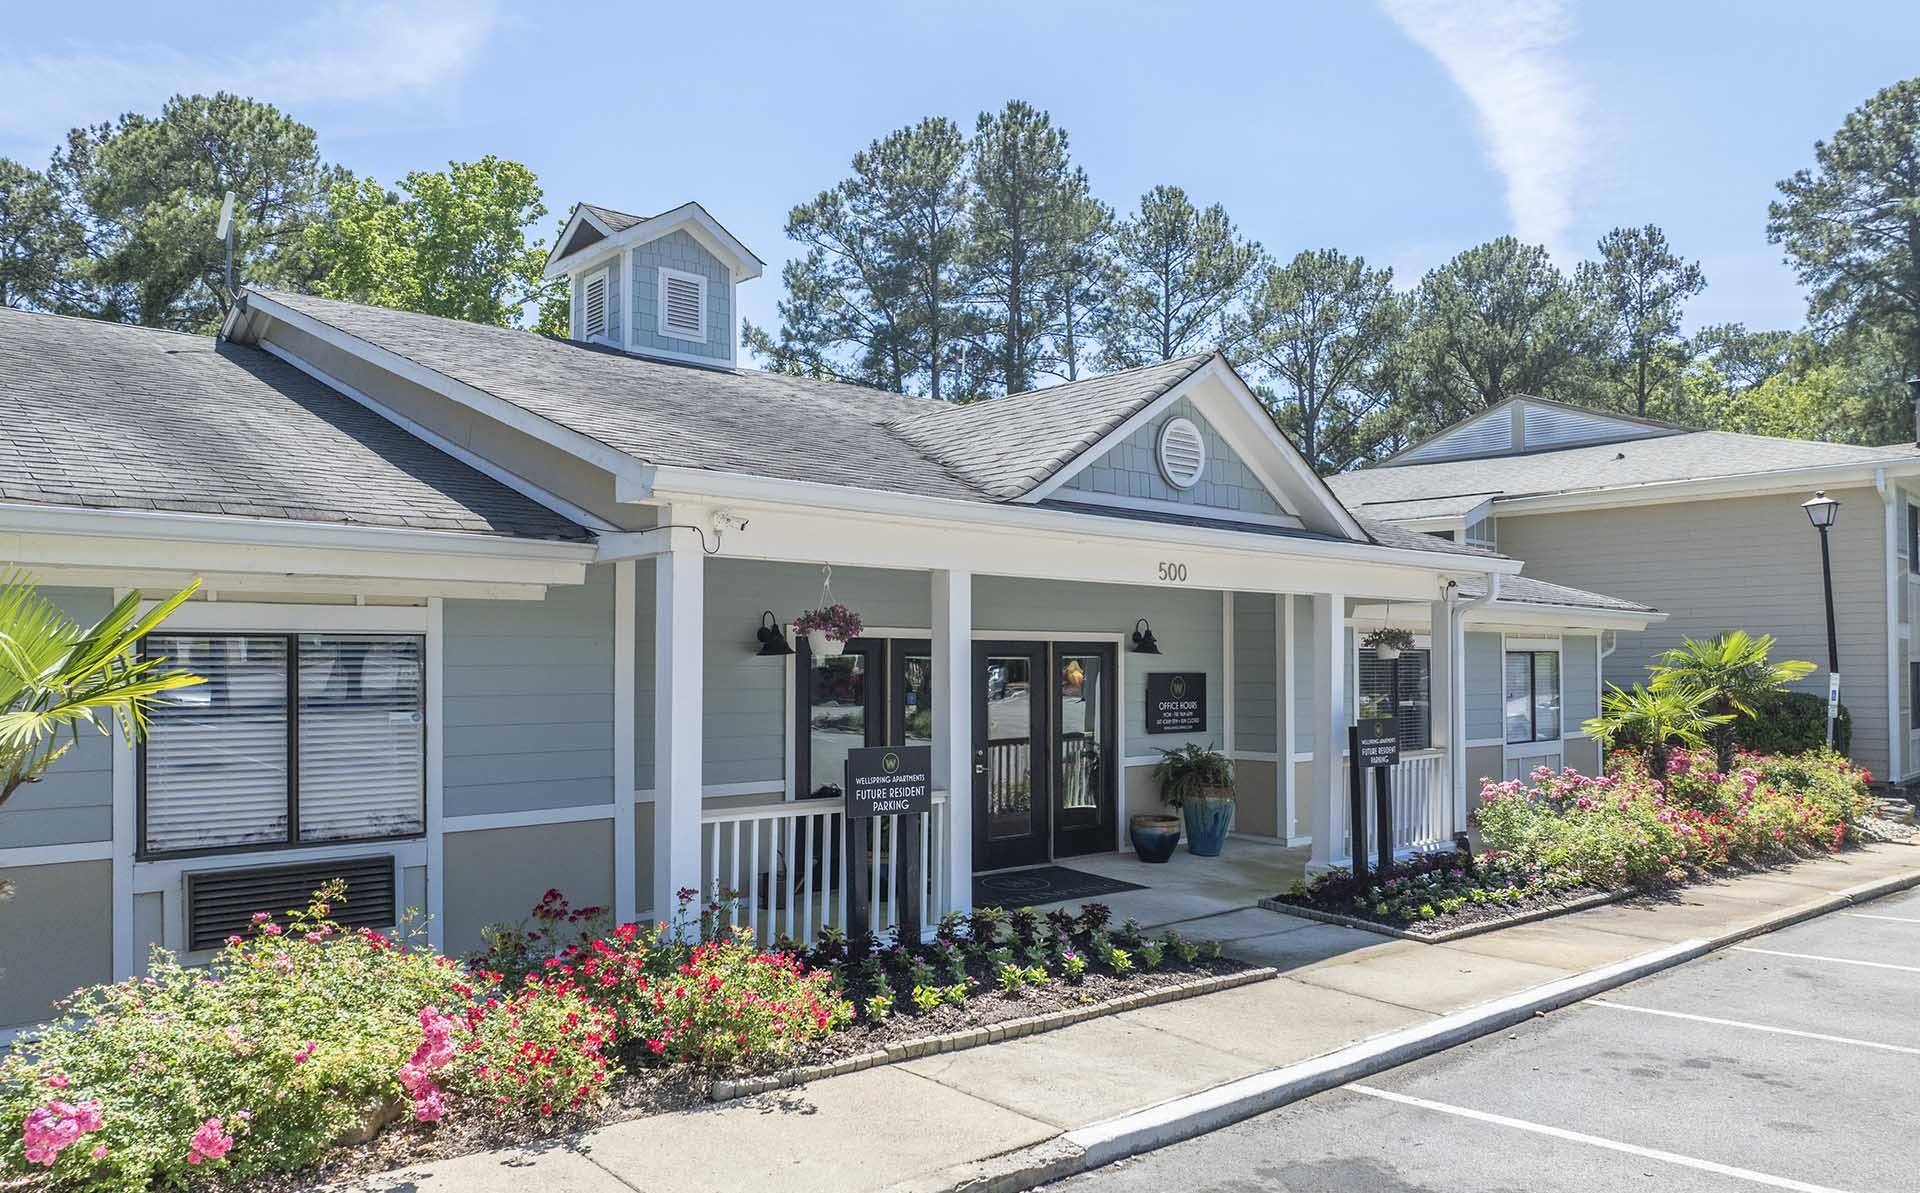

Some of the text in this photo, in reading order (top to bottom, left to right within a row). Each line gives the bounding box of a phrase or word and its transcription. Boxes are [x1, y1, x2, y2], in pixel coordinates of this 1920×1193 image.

[1159, 562, 1187, 581] 500
[1158, 701, 1198, 711] OFFICE HOURS
[1361, 746, 1396, 756] FUTURE RESIDENT
[885, 759, 897, 769] W
[1371, 755, 1389, 763] PARKING
[855, 774, 925, 785] WELLSPRING APARTMENTS
[856, 786, 925, 801] FUTURE RESIDENT
[873, 799, 910, 812] PARKING
